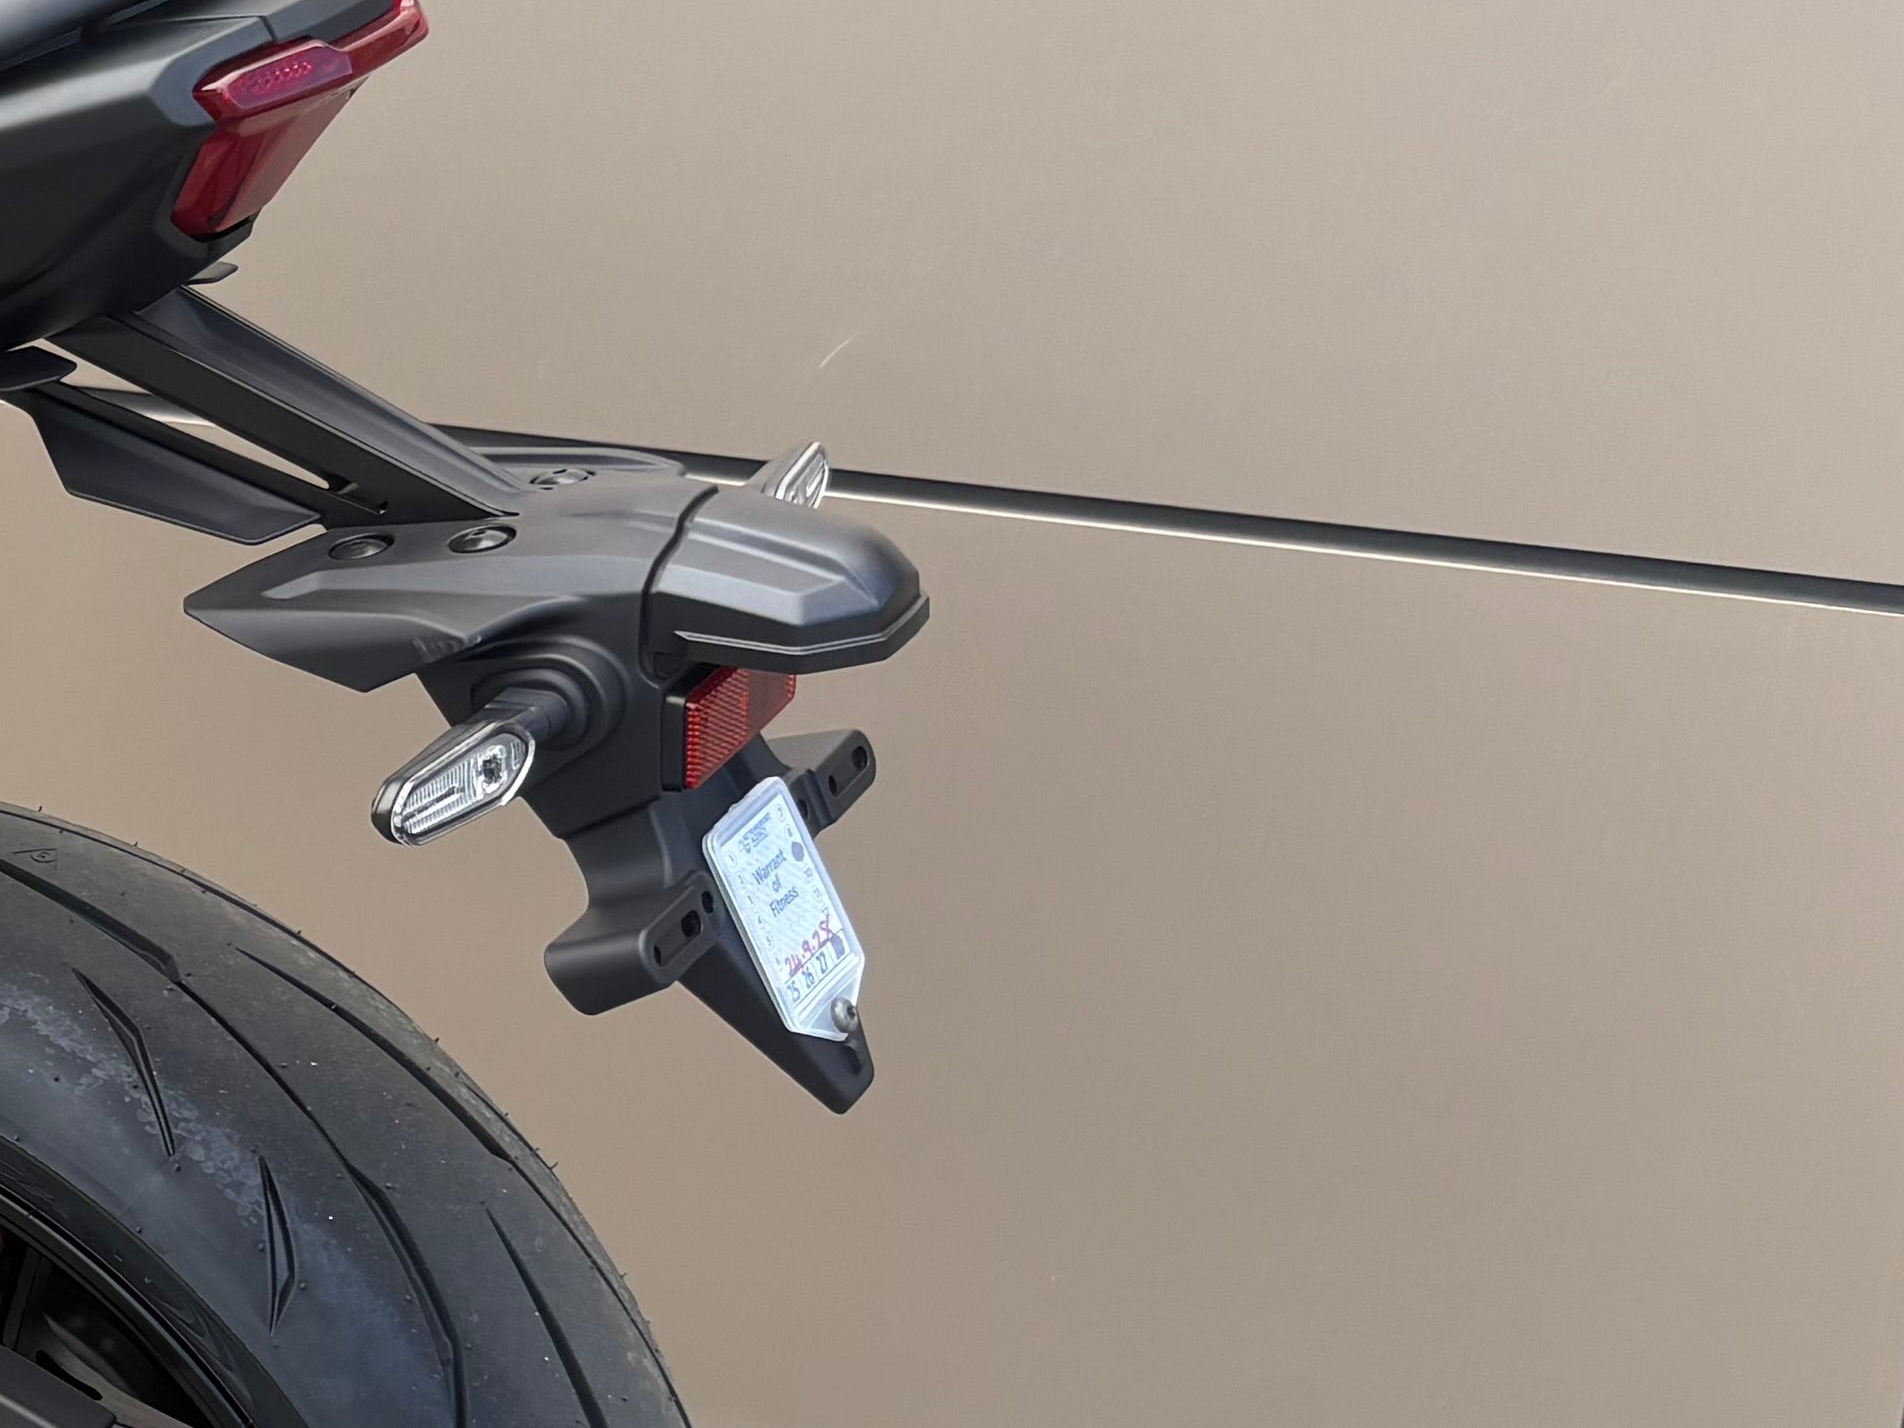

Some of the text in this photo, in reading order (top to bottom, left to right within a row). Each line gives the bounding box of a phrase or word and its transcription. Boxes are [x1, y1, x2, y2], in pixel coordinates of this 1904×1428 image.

[752, 848, 787, 885] Warrant
[771, 873, 783, 893] of
[769, 886, 799, 918] Fitness
